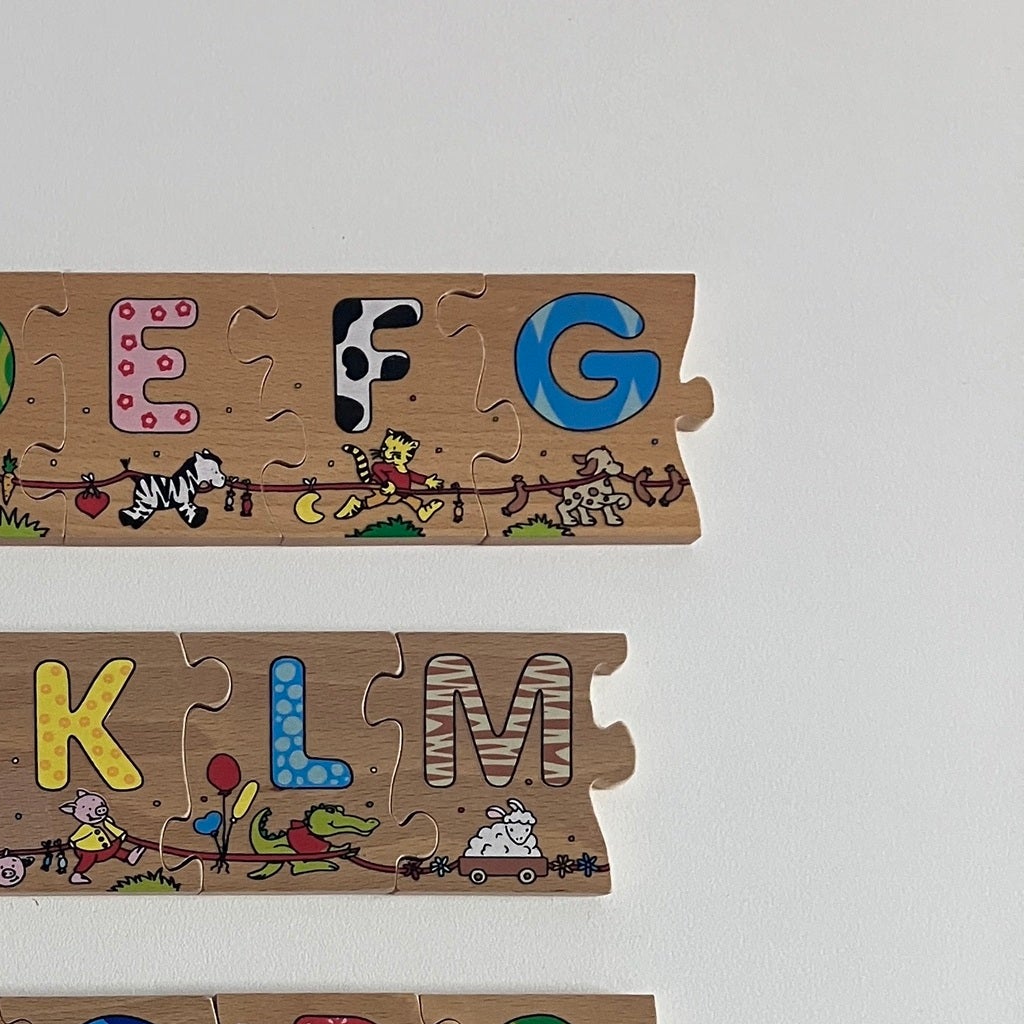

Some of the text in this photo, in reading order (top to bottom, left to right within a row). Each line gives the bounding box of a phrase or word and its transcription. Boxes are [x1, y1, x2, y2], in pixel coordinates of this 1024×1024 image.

[109, 297, 200, 434] E
[333, 297, 422, 434] F
[514, 292, 662, 432] G
[34, 657, 144, 792] K
[269, 656, 354, 789] L
[423, 652, 574, 788] M
